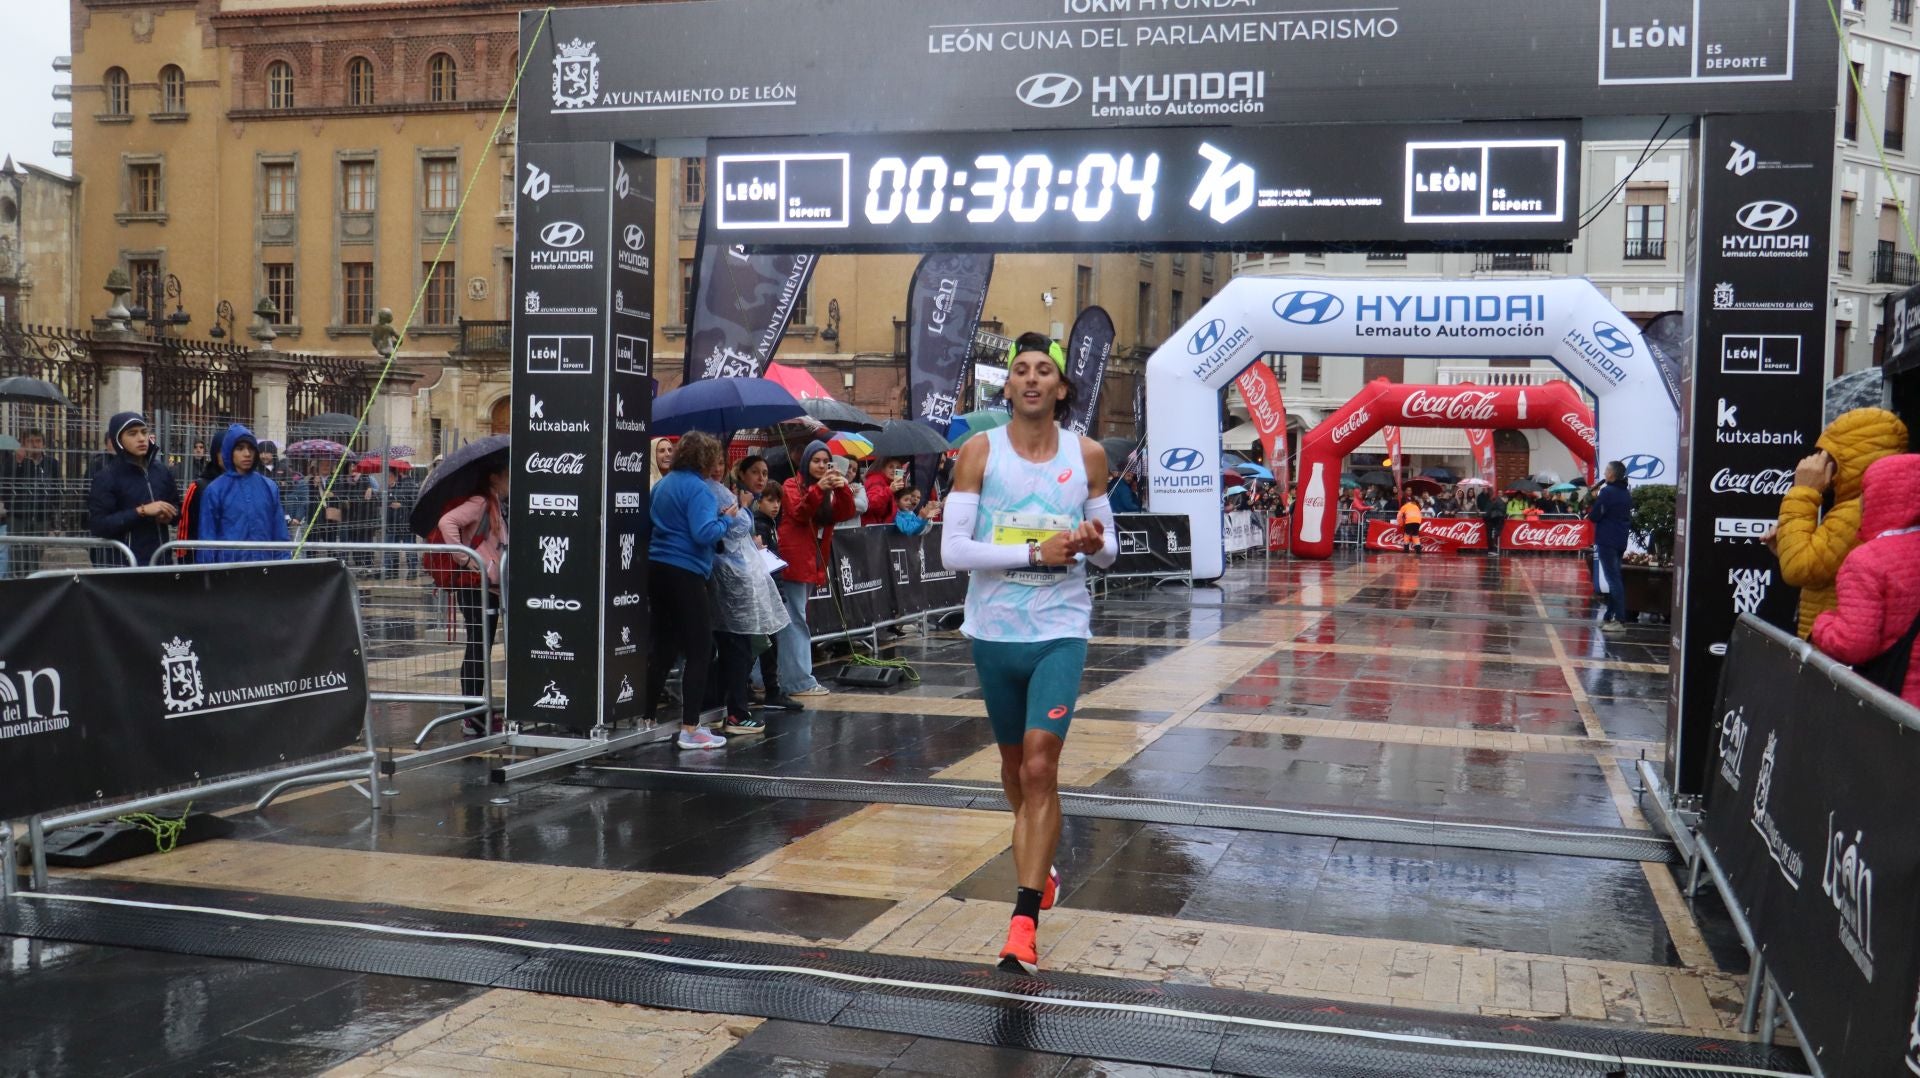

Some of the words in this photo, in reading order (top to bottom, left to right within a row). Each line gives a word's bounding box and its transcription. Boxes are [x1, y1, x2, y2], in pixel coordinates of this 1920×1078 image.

[928, 29, 993, 54] LEÓN
[1000, 31, 1073, 52] CUNA
[1081, 28, 1128, 48] DEL
[1136, 17, 1398, 46] PARLAMENTARISMO
[1612, 19, 1685, 48] LEÓN
[1706, 44, 1722, 55] ES
[1706, 57, 1767, 69] DEPORTE
[602, 87, 724, 105] AYUNTAMIENTO
[729, 86, 749, 101] DE
[754, 82, 797, 100] LEÓN
[1092, 71, 1263, 102] HYUNDAI
[1091, 103, 1161, 118] Lemauto
[1165, 99, 1264, 115] Automoción
[1415, 166, 1477, 192] LEÓN
[725, 177, 777, 201] LEÓN
[864, 152, 1160, 224] 00:30:04
[1493, 189, 1506, 199] ES
[789, 199, 800, 207] ES
[1493, 201, 1542, 211] DEPORTE
[789, 207, 831, 218] DEPORTE
[1722, 235, 1808, 249] HYUNDAI
[531, 250, 593, 263] HYUNDAI
[618, 250, 649, 269] HYUNDAI
[1758, 250, 1808, 258] Automoción
[758, 254, 808, 357] AYUNTAMIENTO
[1356, 295, 1544, 322] HYUNDAI
[1797, 301, 1813, 309] LEÓN
[1355, 324, 1431, 337] Lemauto
[1435, 323, 1544, 337] Automoción
[531, 347, 557, 359] LEÓN
[617, 347, 631, 360] LEÓN
[1193, 325, 1249, 378] HYUNDAI
[1202, 361, 1224, 383] Lemauto
[1223, 334, 1255, 363] Automoción
[1567, 328, 1627, 382] HYUNDAI
[1726, 347, 1757, 359] LEÓN
[1562, 337, 1586, 359] Lemauto
[1585, 358, 1617, 387] Automoción
[1402, 389, 1497, 422] Coca-Cola
[529, 420, 590, 432] kutxabank
[615, 419, 646, 432] kutxabank
[1331, 406, 1370, 444] Coca-Cola
[1716, 429, 1803, 445] kutxabank
[525, 452, 586, 475] Coca-Cola
[614, 451, 643, 473] Coca-Cola
[1153, 475, 1213, 487] HYUNDAI
[1709, 467, 1796, 495] Coca-Cola
[531, 496, 577, 507] LEON
[616, 495, 639, 505] LEON
[619, 533, 634, 547] KAM
[1419, 521, 1484, 545] Coca-Cola
[1511, 523, 1584, 547] Coca-Cola
[1714, 537, 1766, 545] PLA
[539, 536, 569, 550] KAM
[542, 548, 565, 562] ARI
[543, 560, 563, 574] NY
[1728, 568, 1771, 586] KAM
[613, 590, 640, 606] emico
[1732, 584, 1765, 600] ARI
[526, 594, 581, 610] emico
[1734, 597, 1763, 614] NY
[208, 682, 298, 706] AYUNTAMIENTO
[300, 678, 312, 691] DE
[315, 670, 347, 689] LEÓN
[3, 704, 21, 721] del
[0, 716, 70, 739] mentarismo
